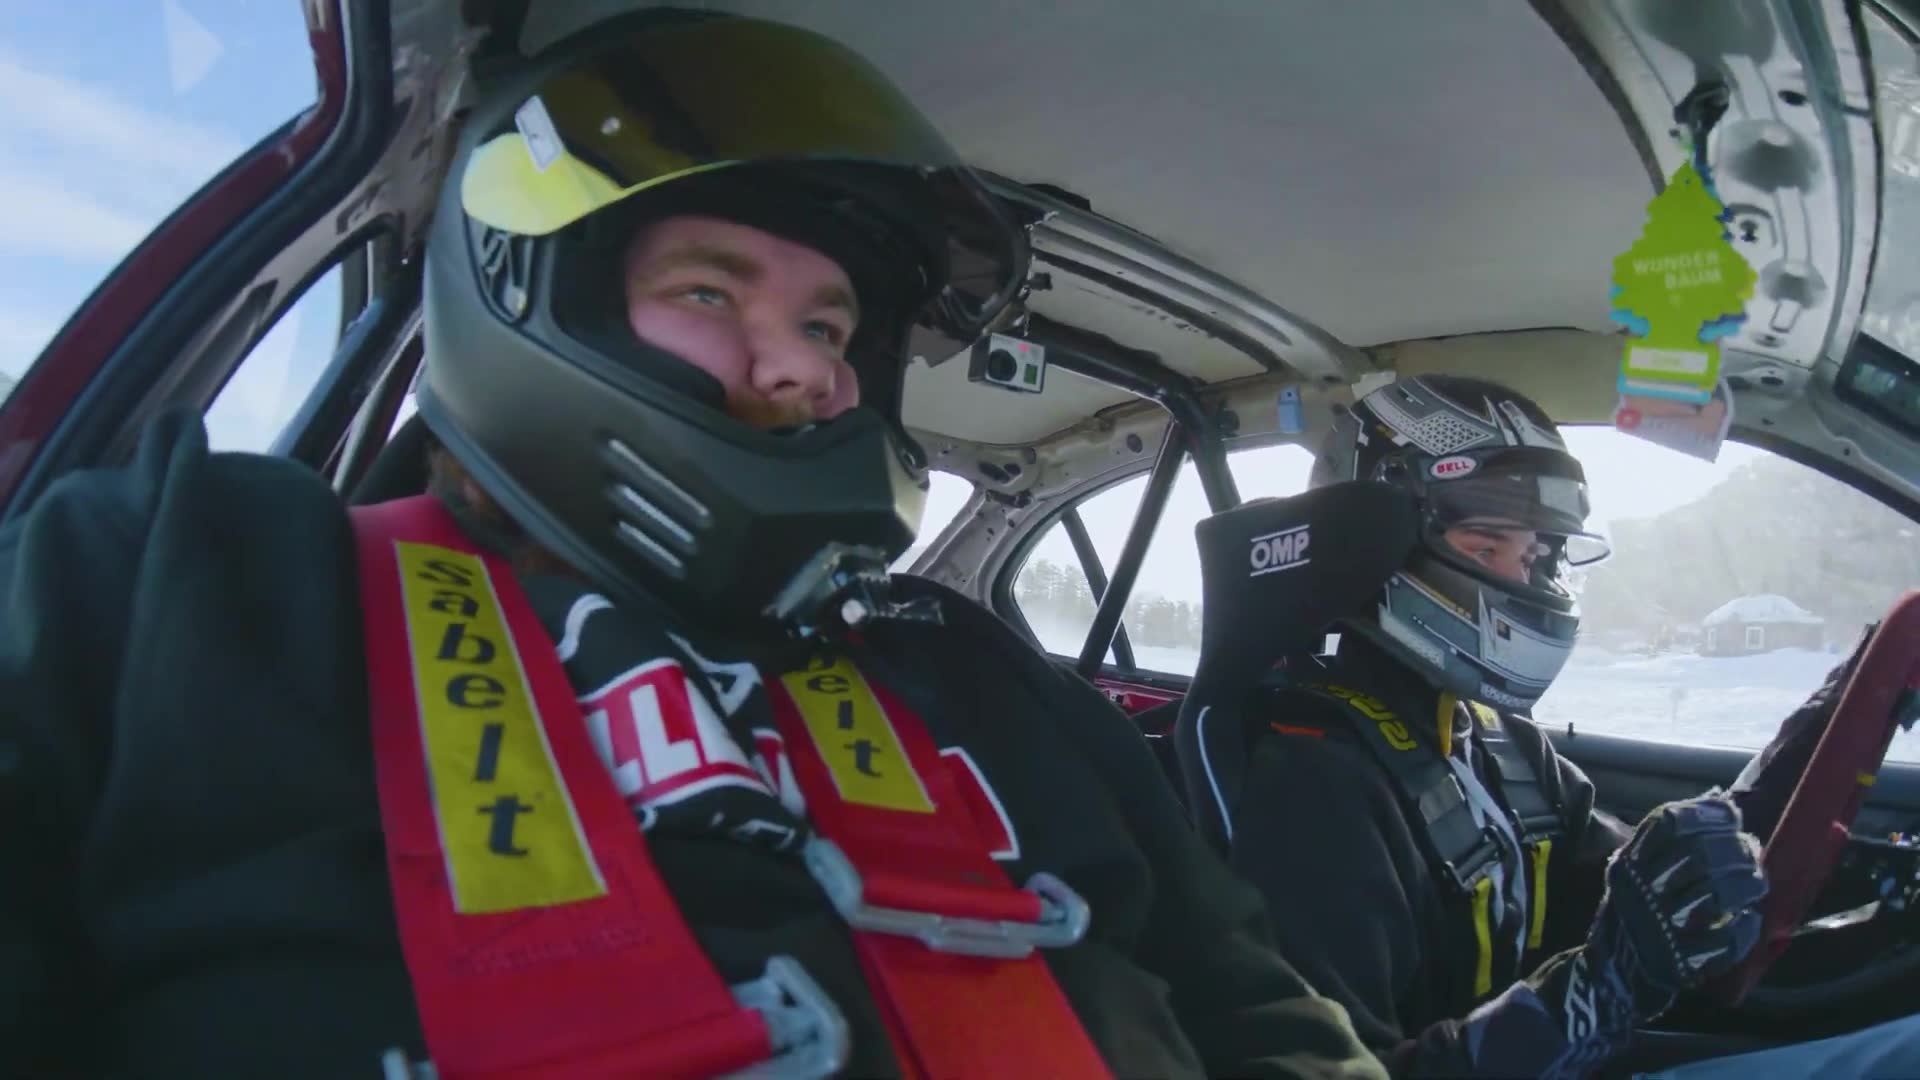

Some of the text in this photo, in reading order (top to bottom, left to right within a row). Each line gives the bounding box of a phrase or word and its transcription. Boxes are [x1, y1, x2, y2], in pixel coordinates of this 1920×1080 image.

[1632, 251, 1719, 275] WUNDER
[1436, 460, 1470, 474] BELL
[1251, 531, 1310, 569] OMP
